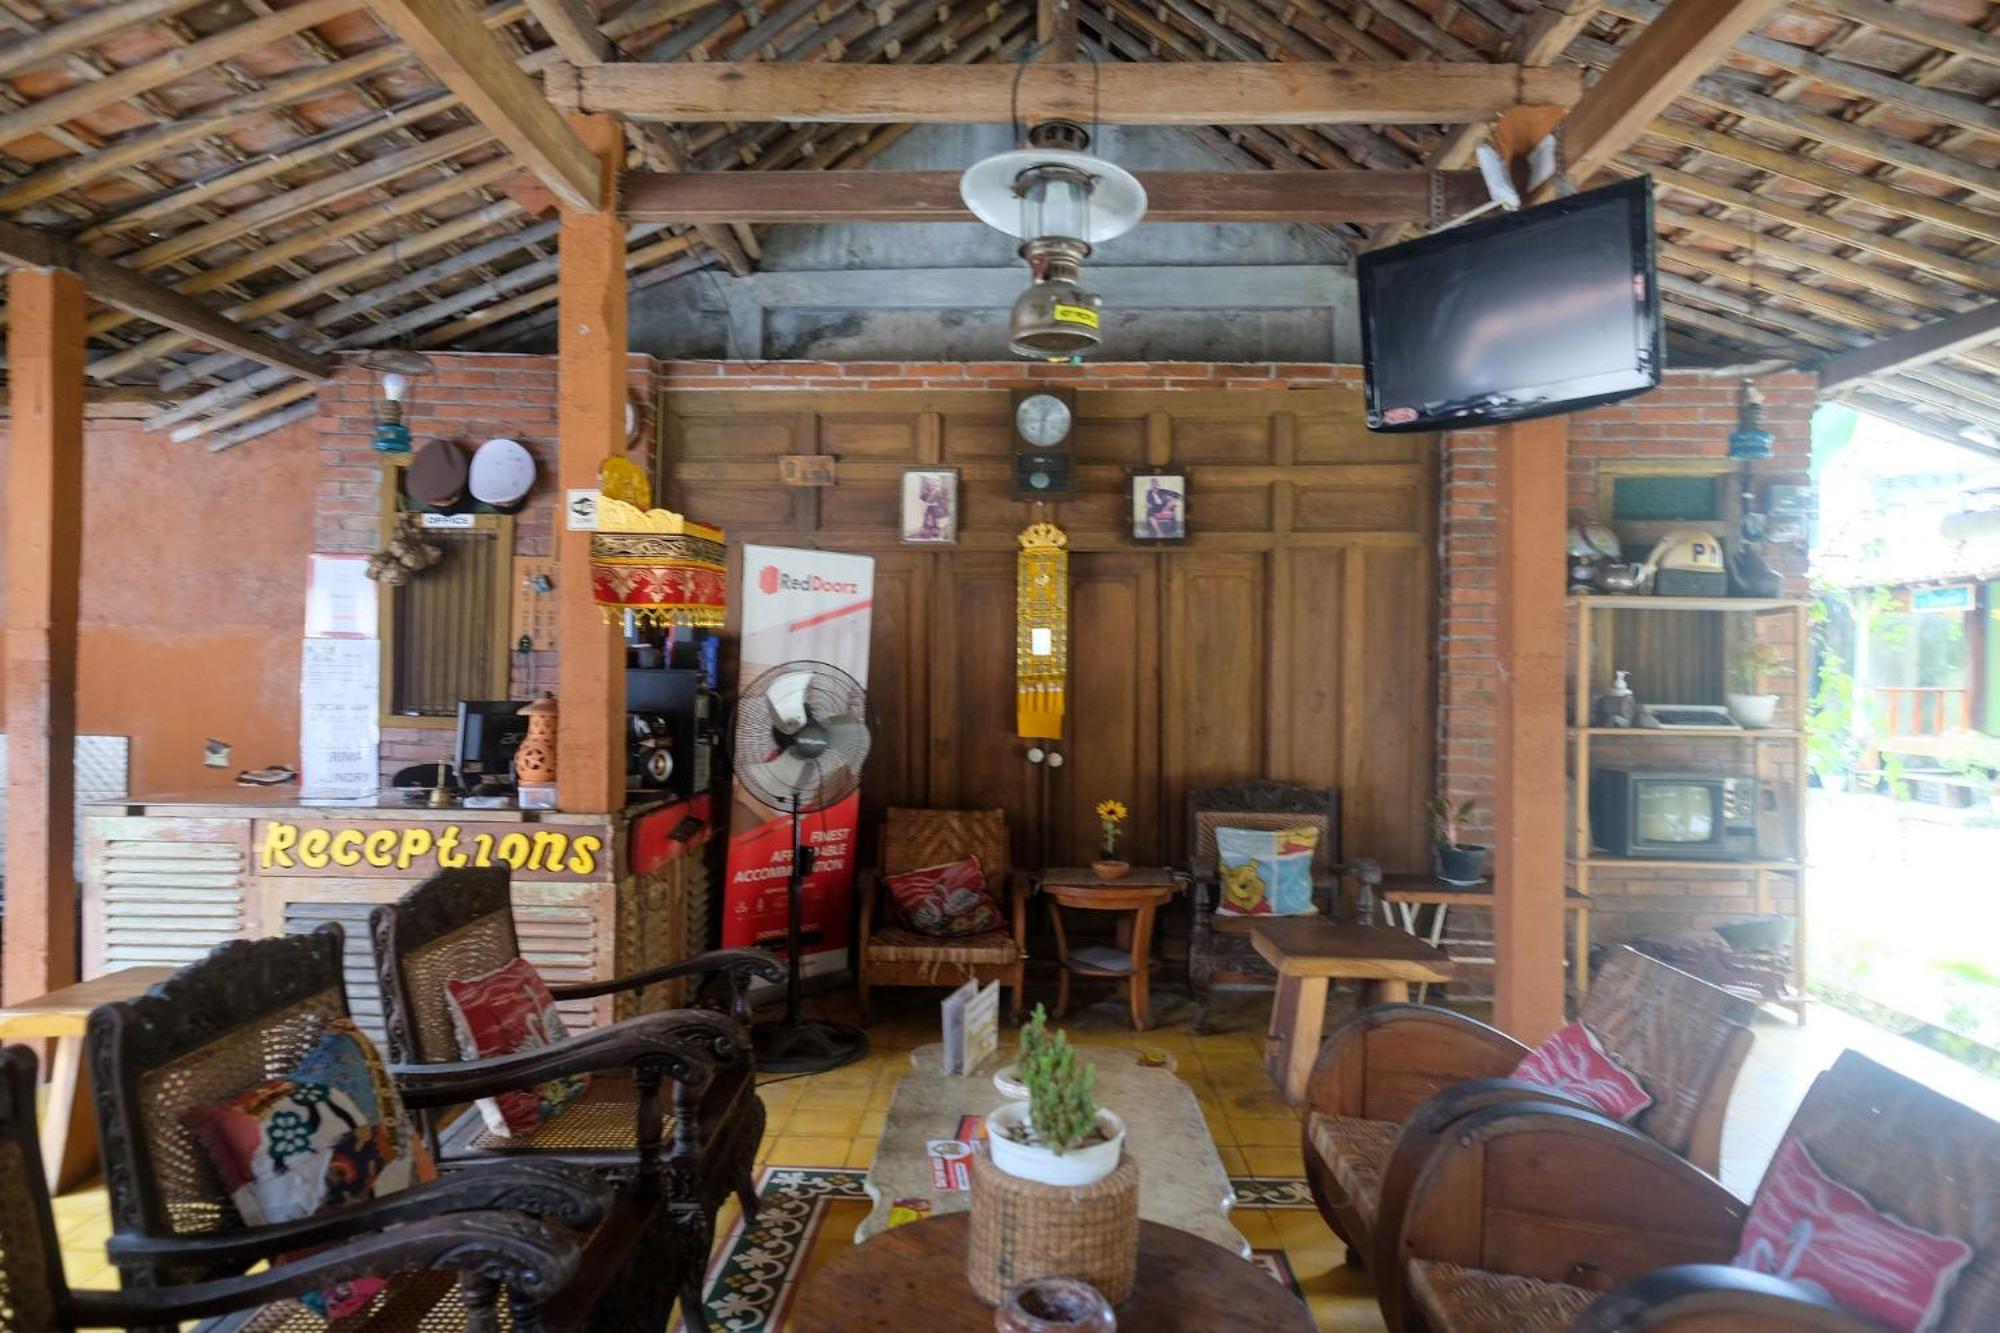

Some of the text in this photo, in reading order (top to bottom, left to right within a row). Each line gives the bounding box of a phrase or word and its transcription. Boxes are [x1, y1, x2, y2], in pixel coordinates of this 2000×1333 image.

[781, 572, 859, 595] RedDoorz
[811, 828, 850, 843] FINEST
[260, 820, 604, 875] Receptions
